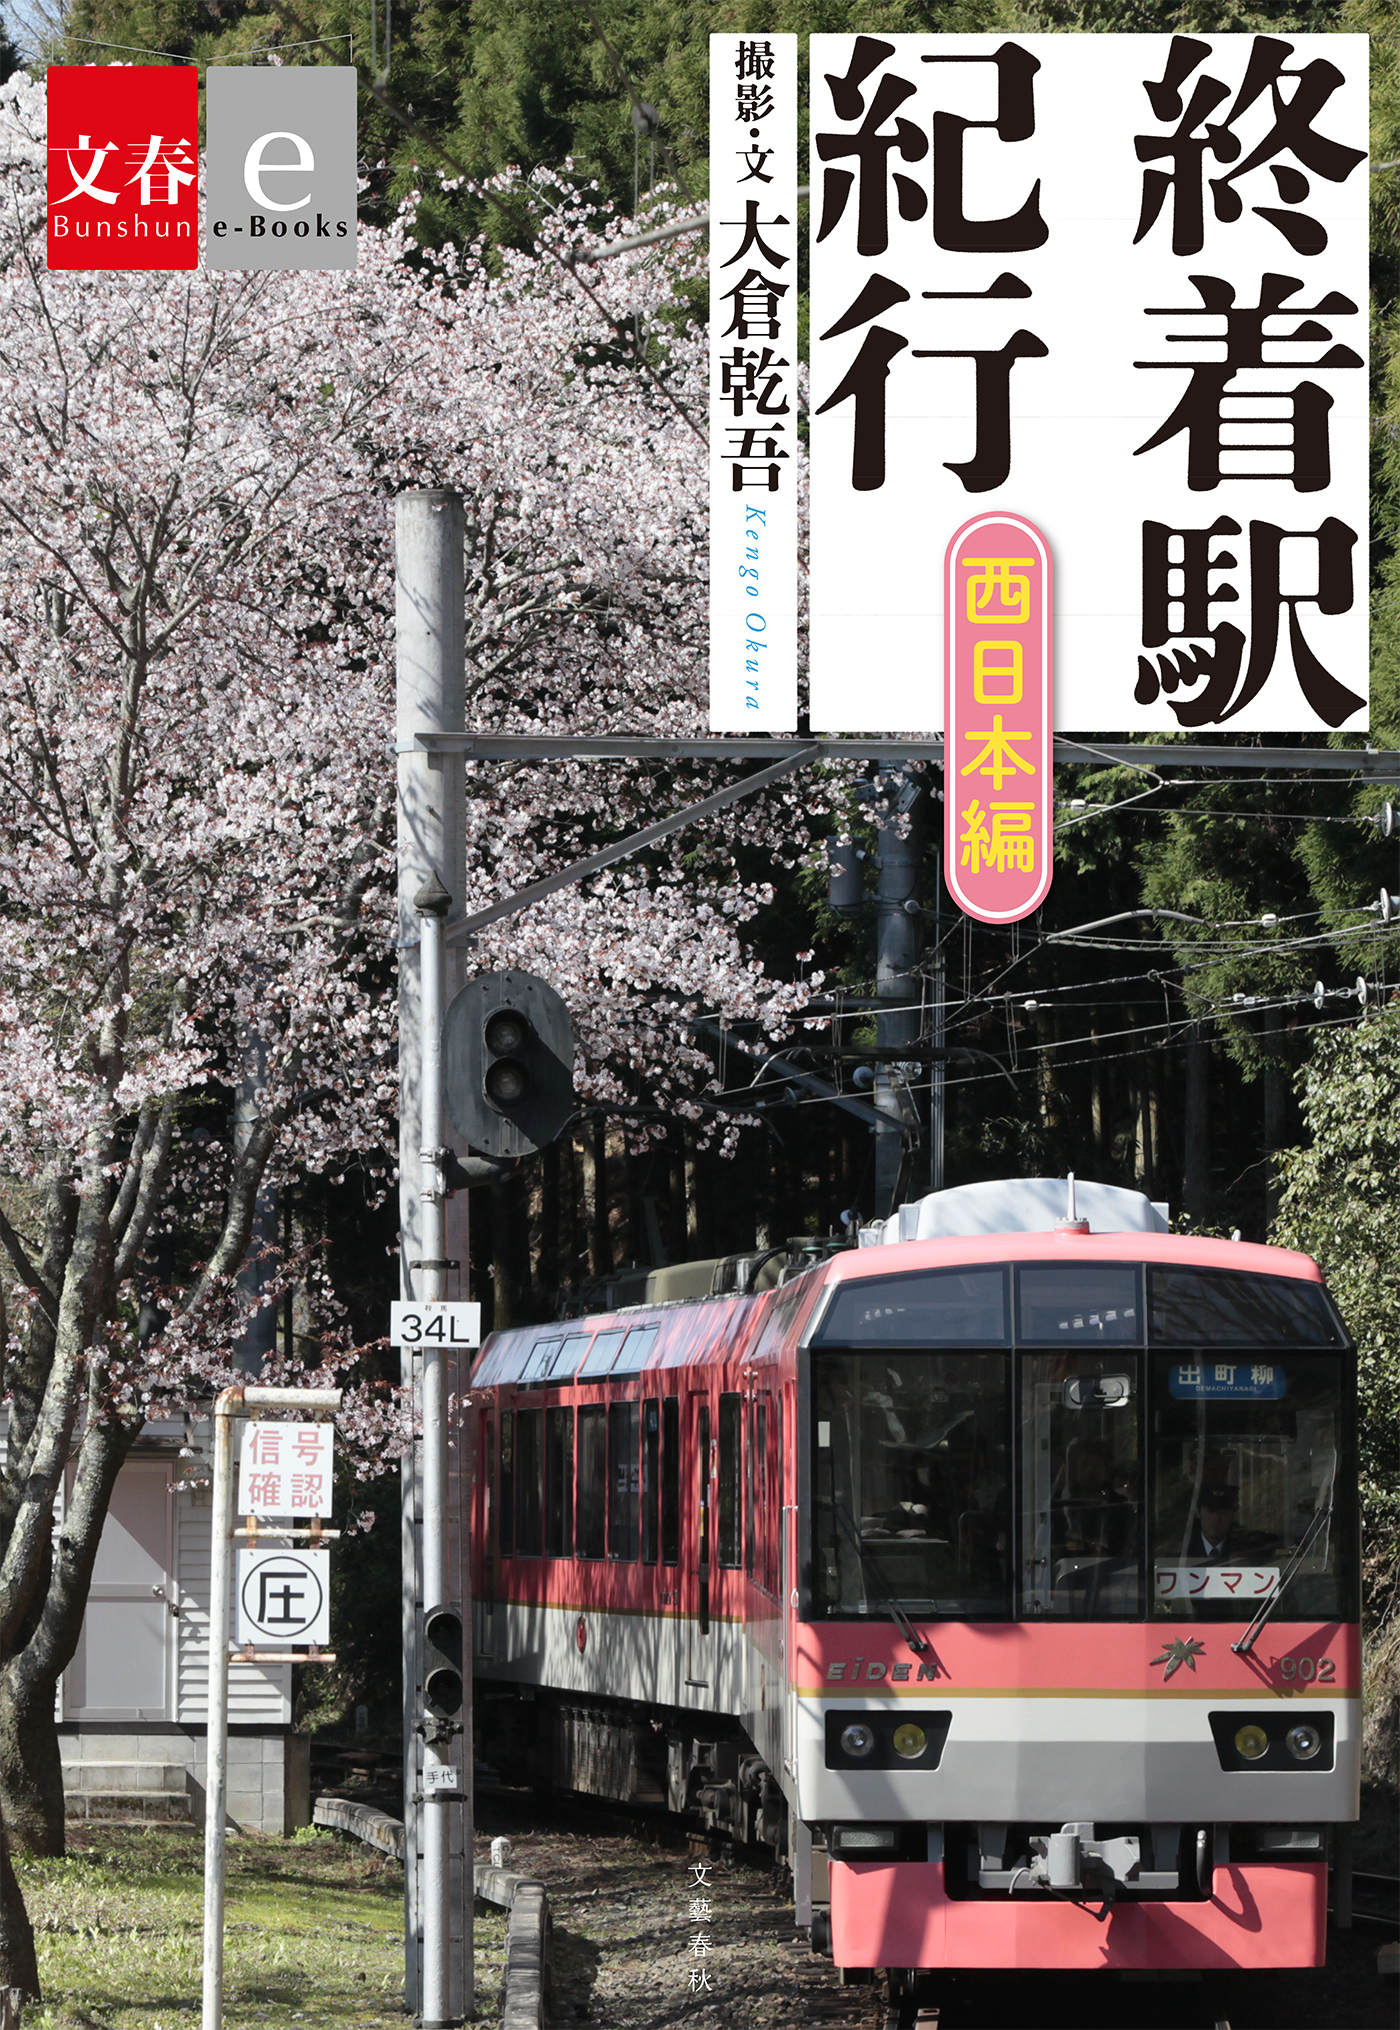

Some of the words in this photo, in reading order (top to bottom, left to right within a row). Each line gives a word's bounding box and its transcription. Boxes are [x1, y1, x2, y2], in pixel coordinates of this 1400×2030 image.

[401, 1314, 470, 1343] 34L
[1178, 1364, 1274, 1385] 出町柳
[249, 1430, 324, 1466] 信号
[248, 1472, 324, 1509] 確認
[1157, 1572, 1275, 1595] ワンマン
[257, 1572, 308, 1624] 圧
[1280, 1656, 1335, 1681] 902
[426, 1770, 454, 1784] 手代
